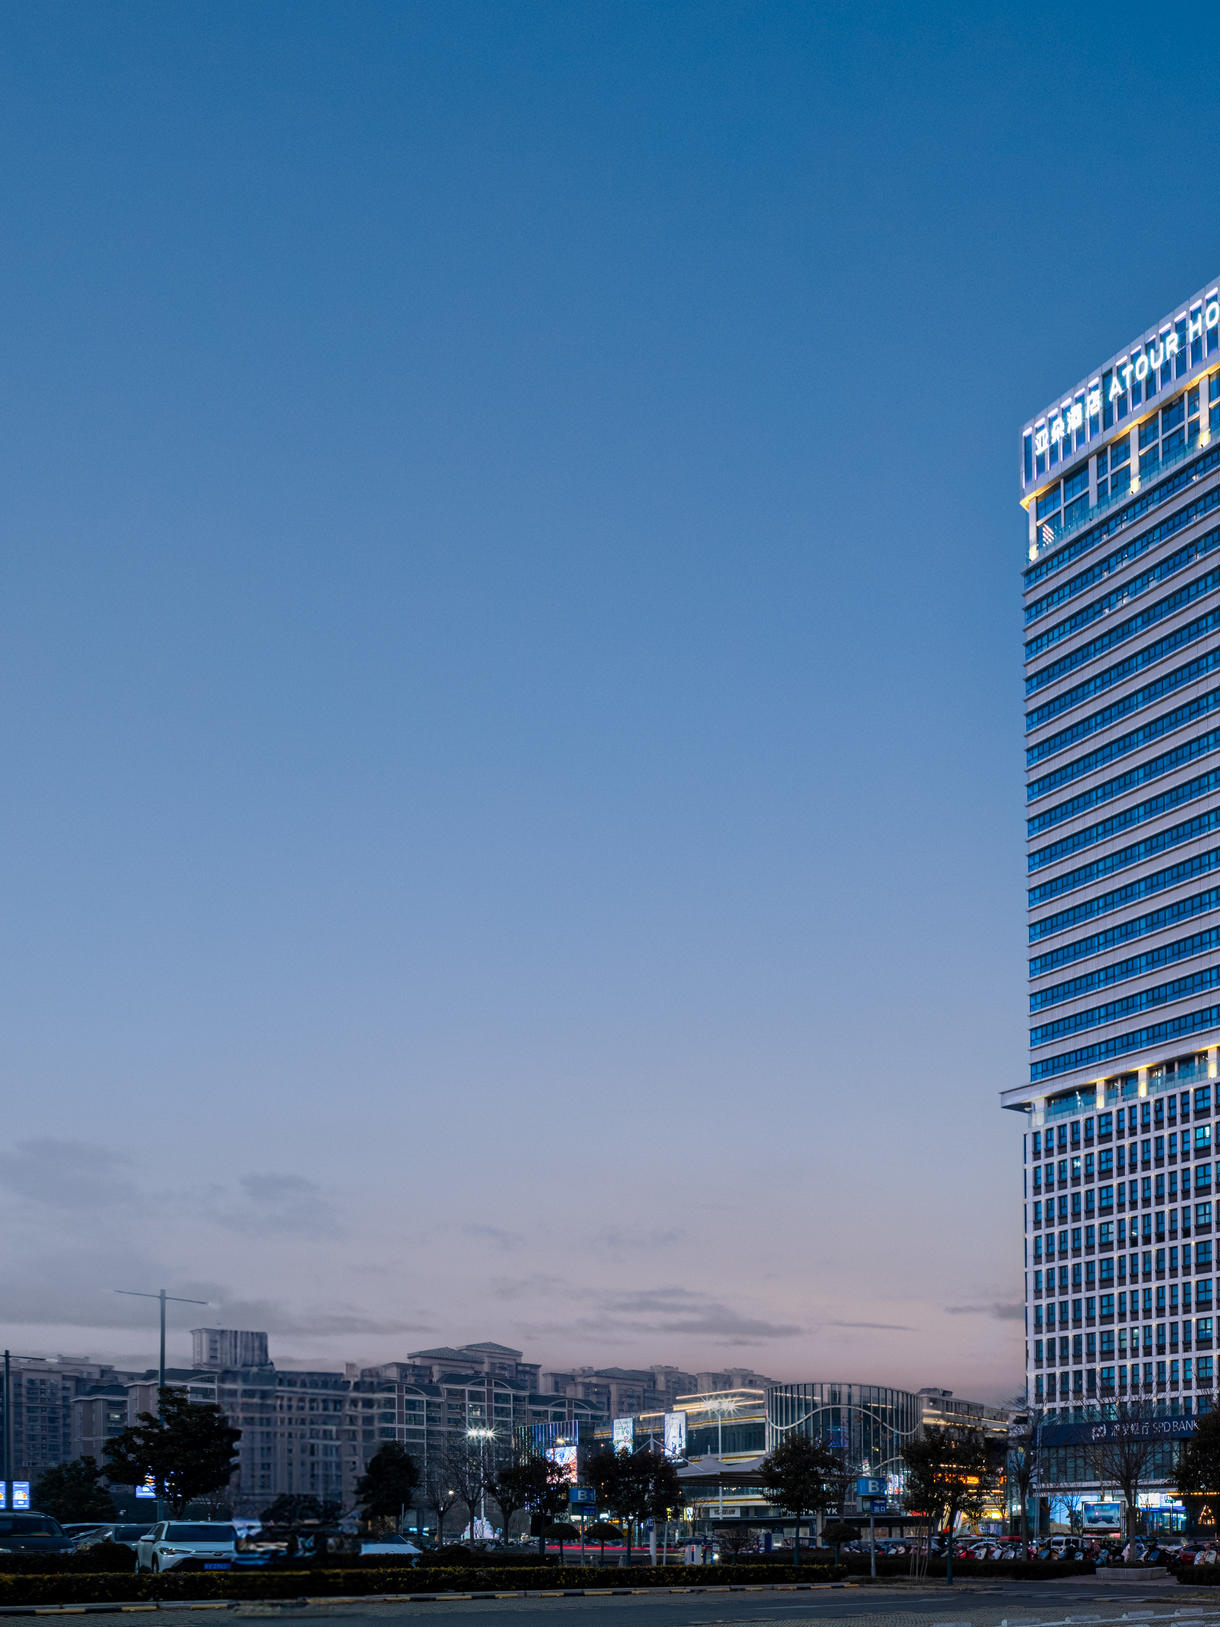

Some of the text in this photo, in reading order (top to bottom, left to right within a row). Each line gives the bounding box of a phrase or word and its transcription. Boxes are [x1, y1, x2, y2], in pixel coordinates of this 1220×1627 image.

[1035, 389, 1100, 456] 亚朵酒店
[1109, 332, 1179, 402] ATOUR
[1172, 1419, 1200, 1432] BANK
